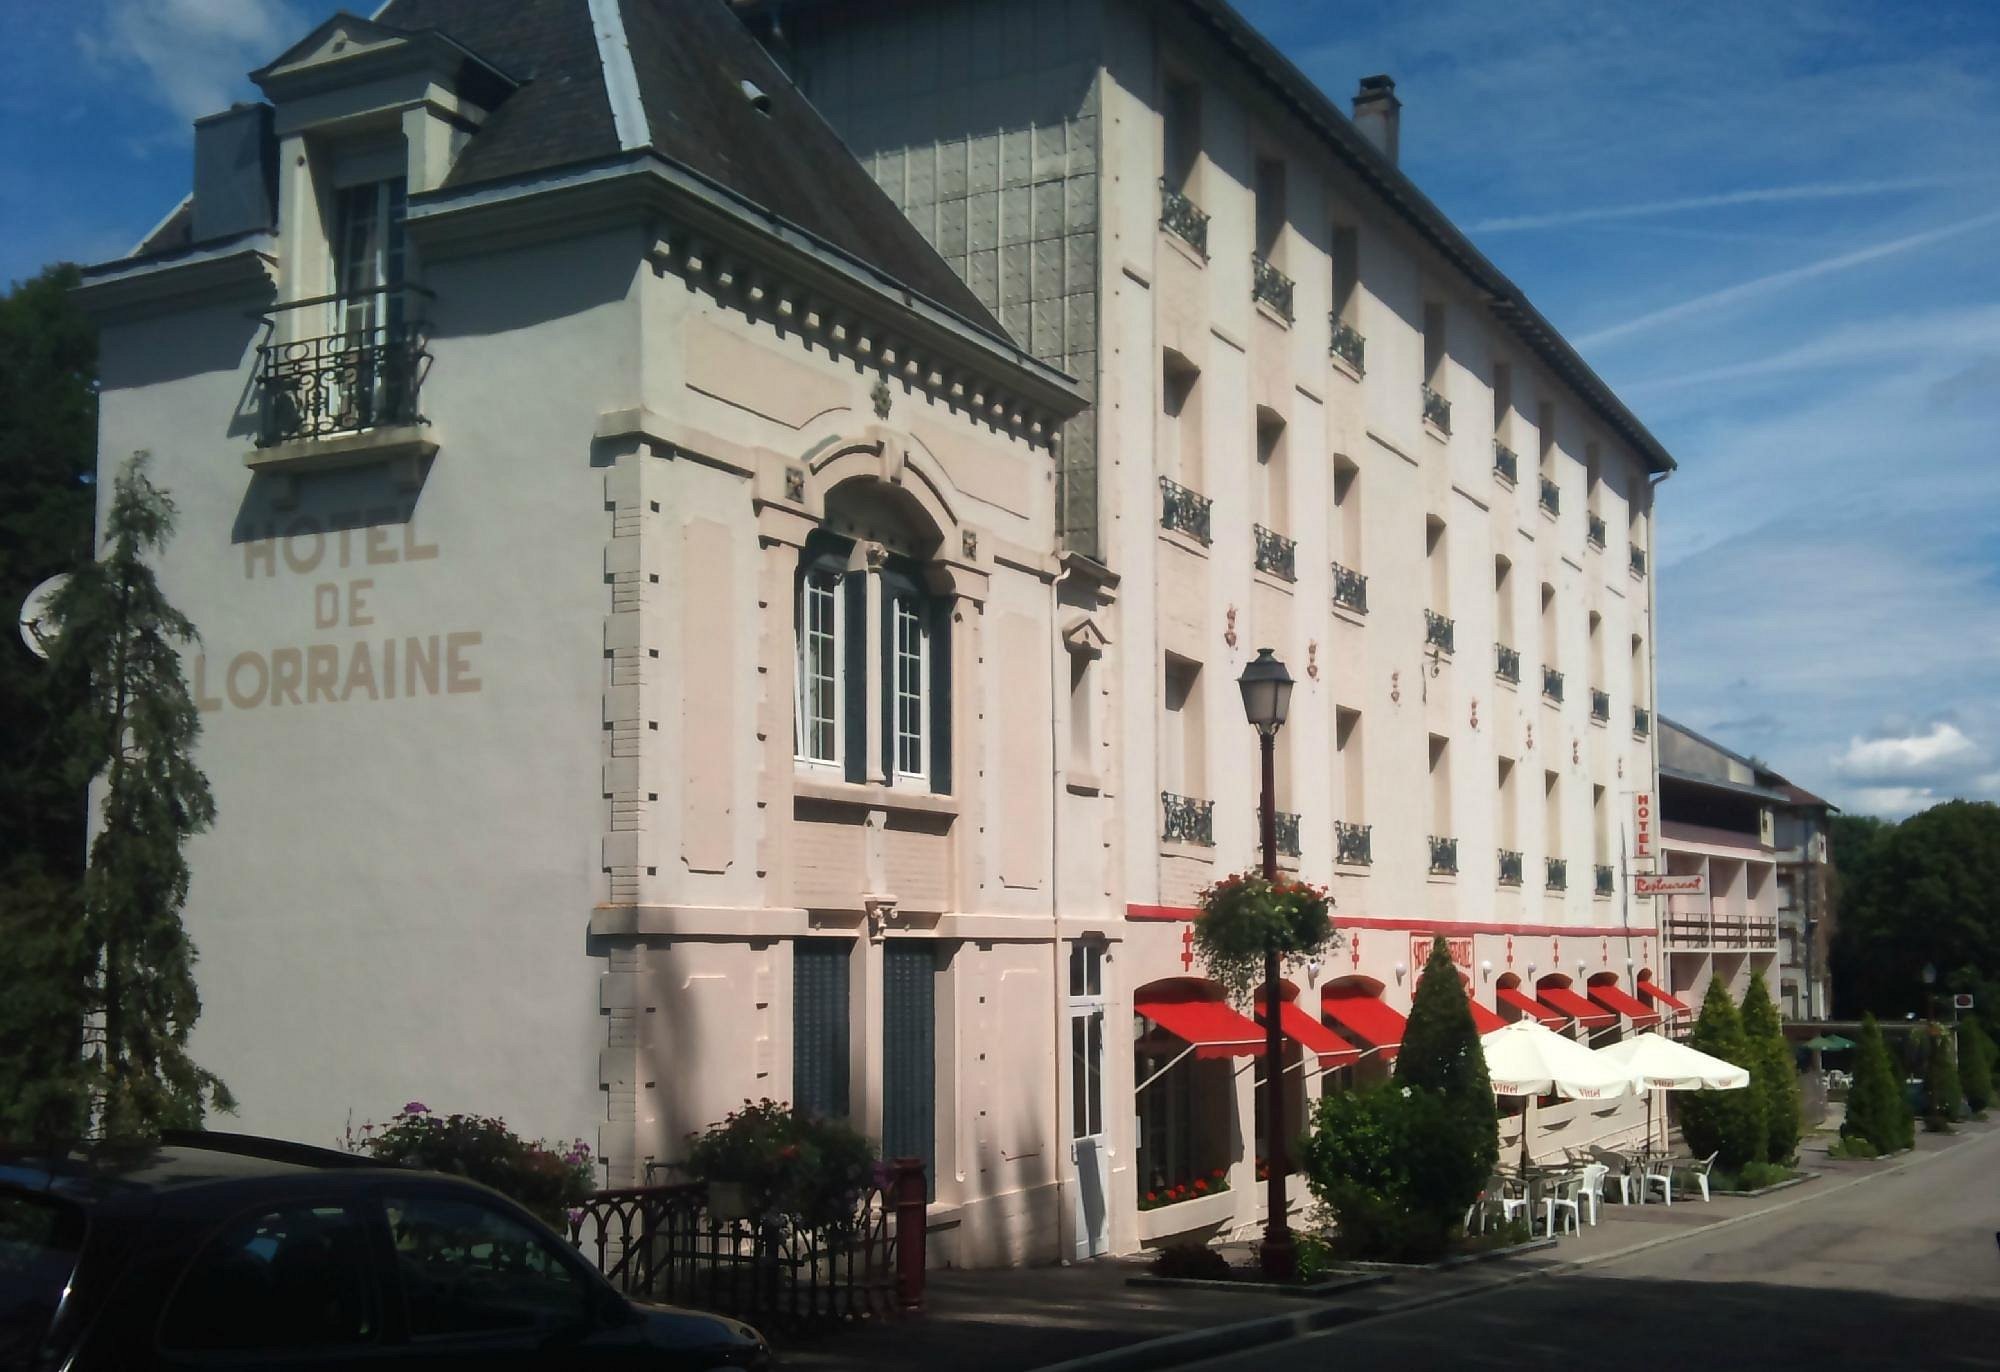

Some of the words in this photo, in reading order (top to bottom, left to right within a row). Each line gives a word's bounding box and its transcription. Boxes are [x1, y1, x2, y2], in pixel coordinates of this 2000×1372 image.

[243, 507, 439, 580] HOTEL
[314, 579, 375, 629] DE
[193, 631, 483, 712] LORRAINE
[1638, 795, 1649, 855] HOTEL
[1637, 876, 1702, 892] Restaurant
[1493, 1082, 1518, 1094] Vittel
